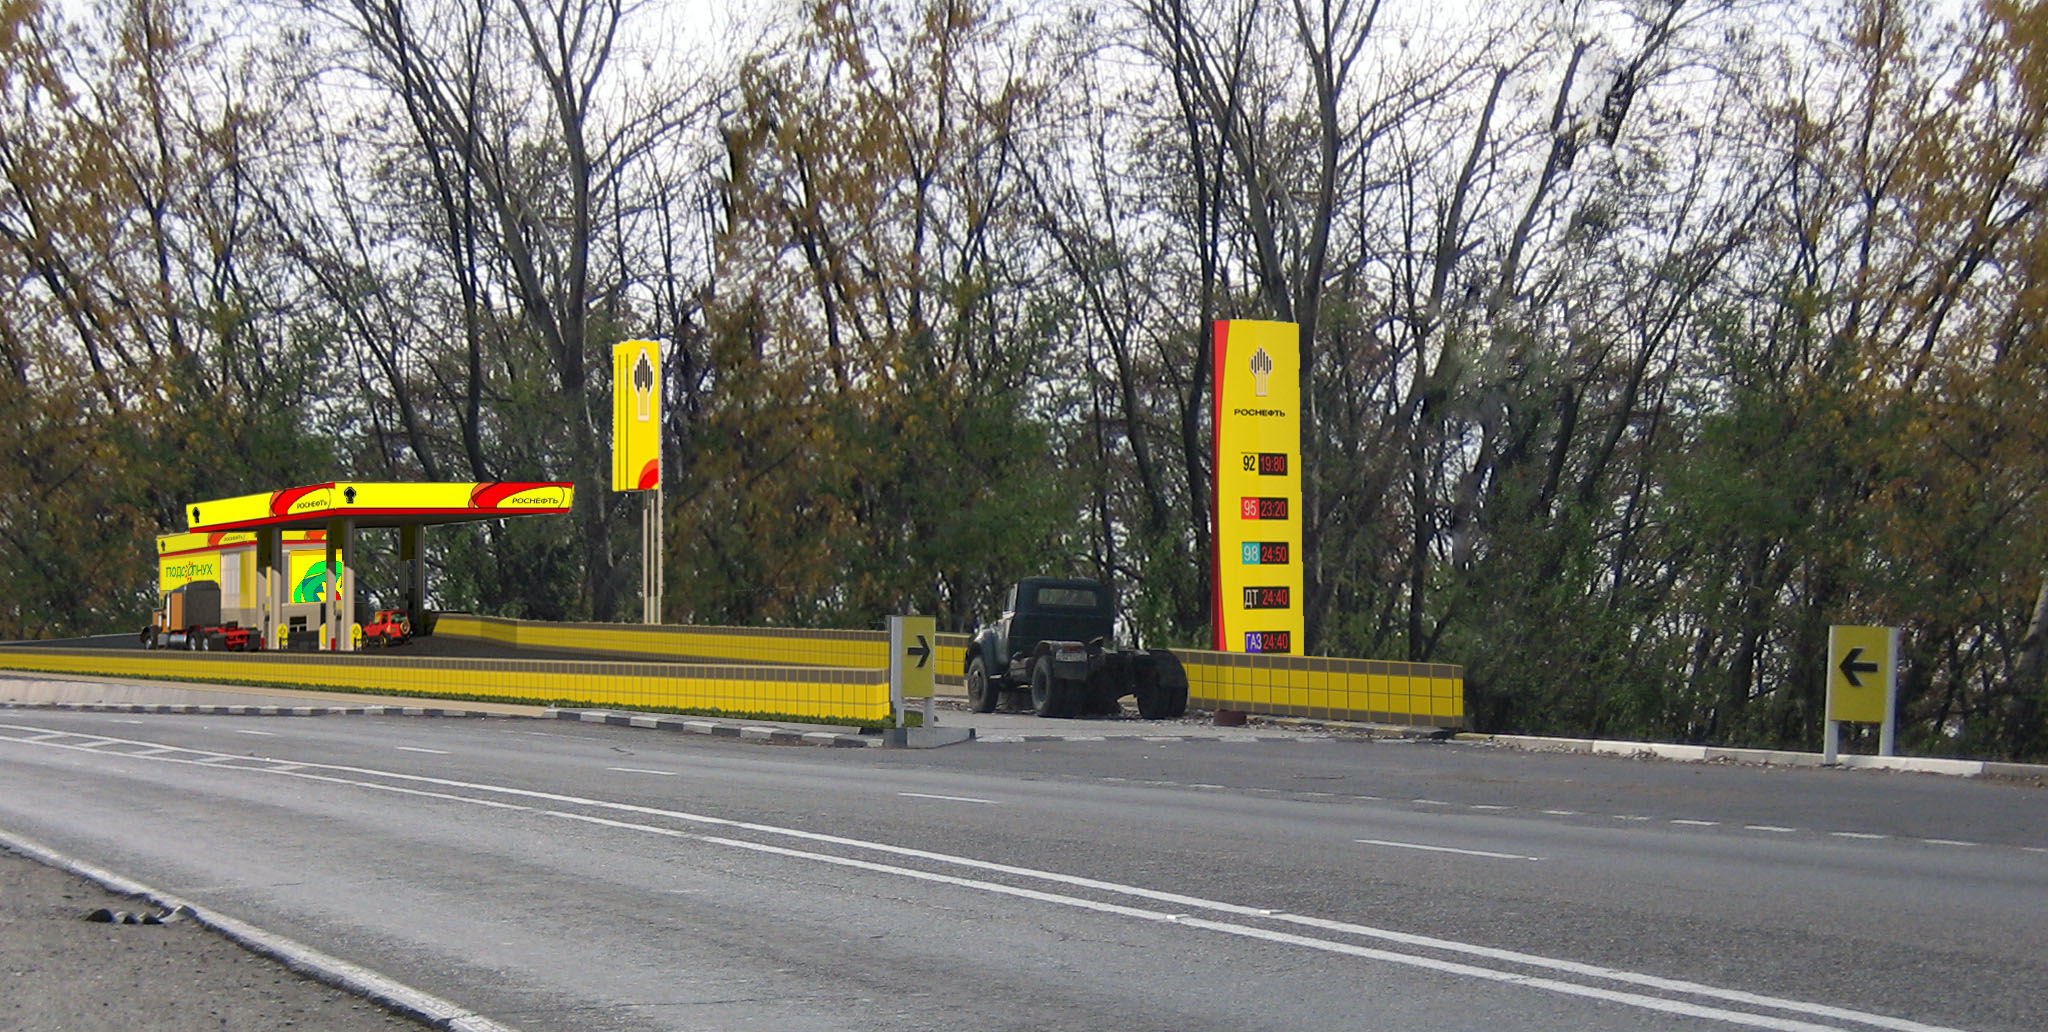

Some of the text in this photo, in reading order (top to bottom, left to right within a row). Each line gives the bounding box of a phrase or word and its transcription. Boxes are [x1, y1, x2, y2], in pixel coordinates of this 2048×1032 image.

[1233, 408, 1286, 417] РОСНЕФТЬ
[1243, 455, 1285, 472] 92 19:80
[1243, 500, 1286, 517] 95 23:20
[1243, 545, 1287, 562] 98 24:50
[1244, 589, 1288, 608] ДТ 24:40
[1245, 633, 1288, 650] ГАЗ 24:40
